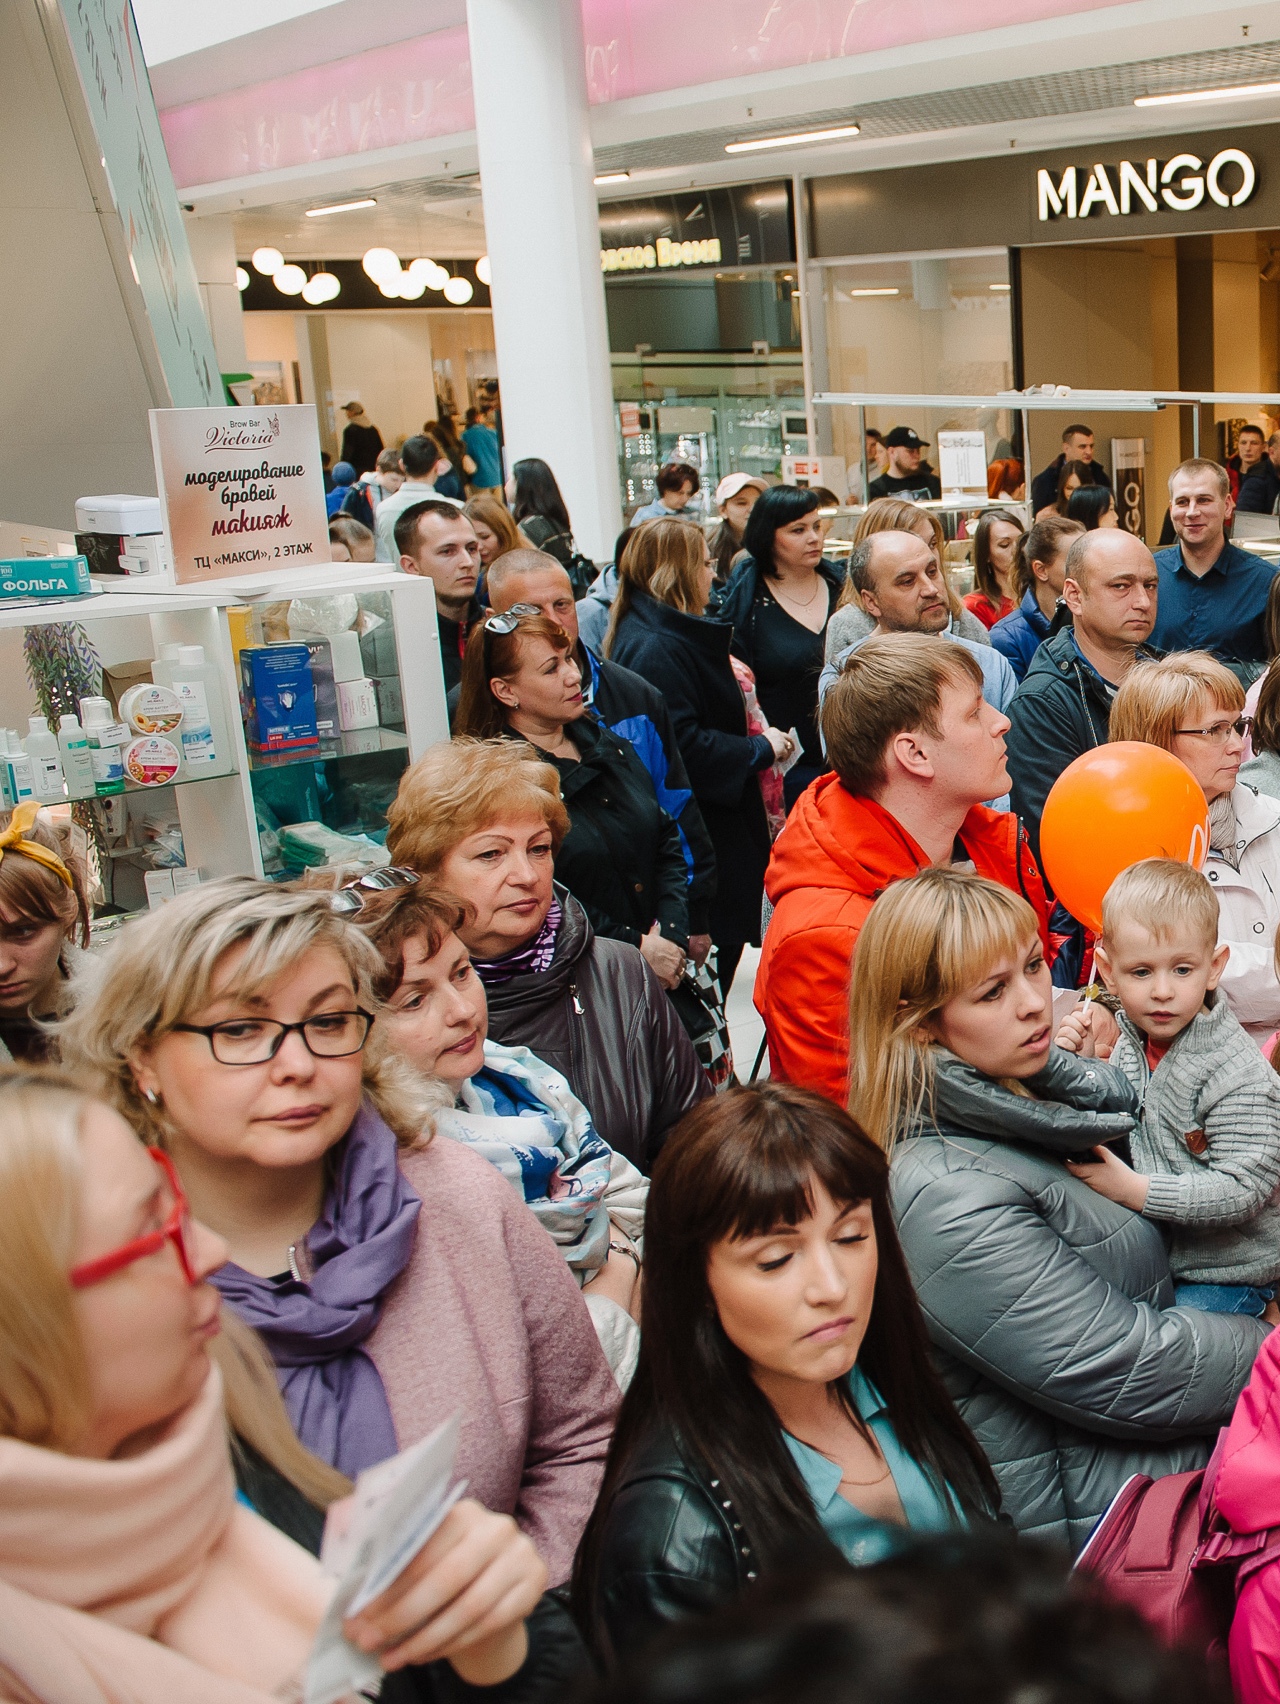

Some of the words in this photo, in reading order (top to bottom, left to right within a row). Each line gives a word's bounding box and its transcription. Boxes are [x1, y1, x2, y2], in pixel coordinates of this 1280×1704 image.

[1037, 148, 1256, 221] MANGO
[656, 237, 722, 269] Время
[204, 426, 275, 448] Victoria
[229, 420, 247, 428] Brow
[249, 420, 261, 428] Bar
[184, 461, 305, 491] моделирование
[221, 483, 277, 512] бровей
[211, 505, 293, 536] макияж
[194, 556, 212, 569] ТЦ
[214, 548, 272, 566] «МАКСИ»,
[274, 546, 281, 558] 2
[283, 543, 313, 557] ЭТАЖ
[2, 578, 68, 592] ФОЛЬГА
